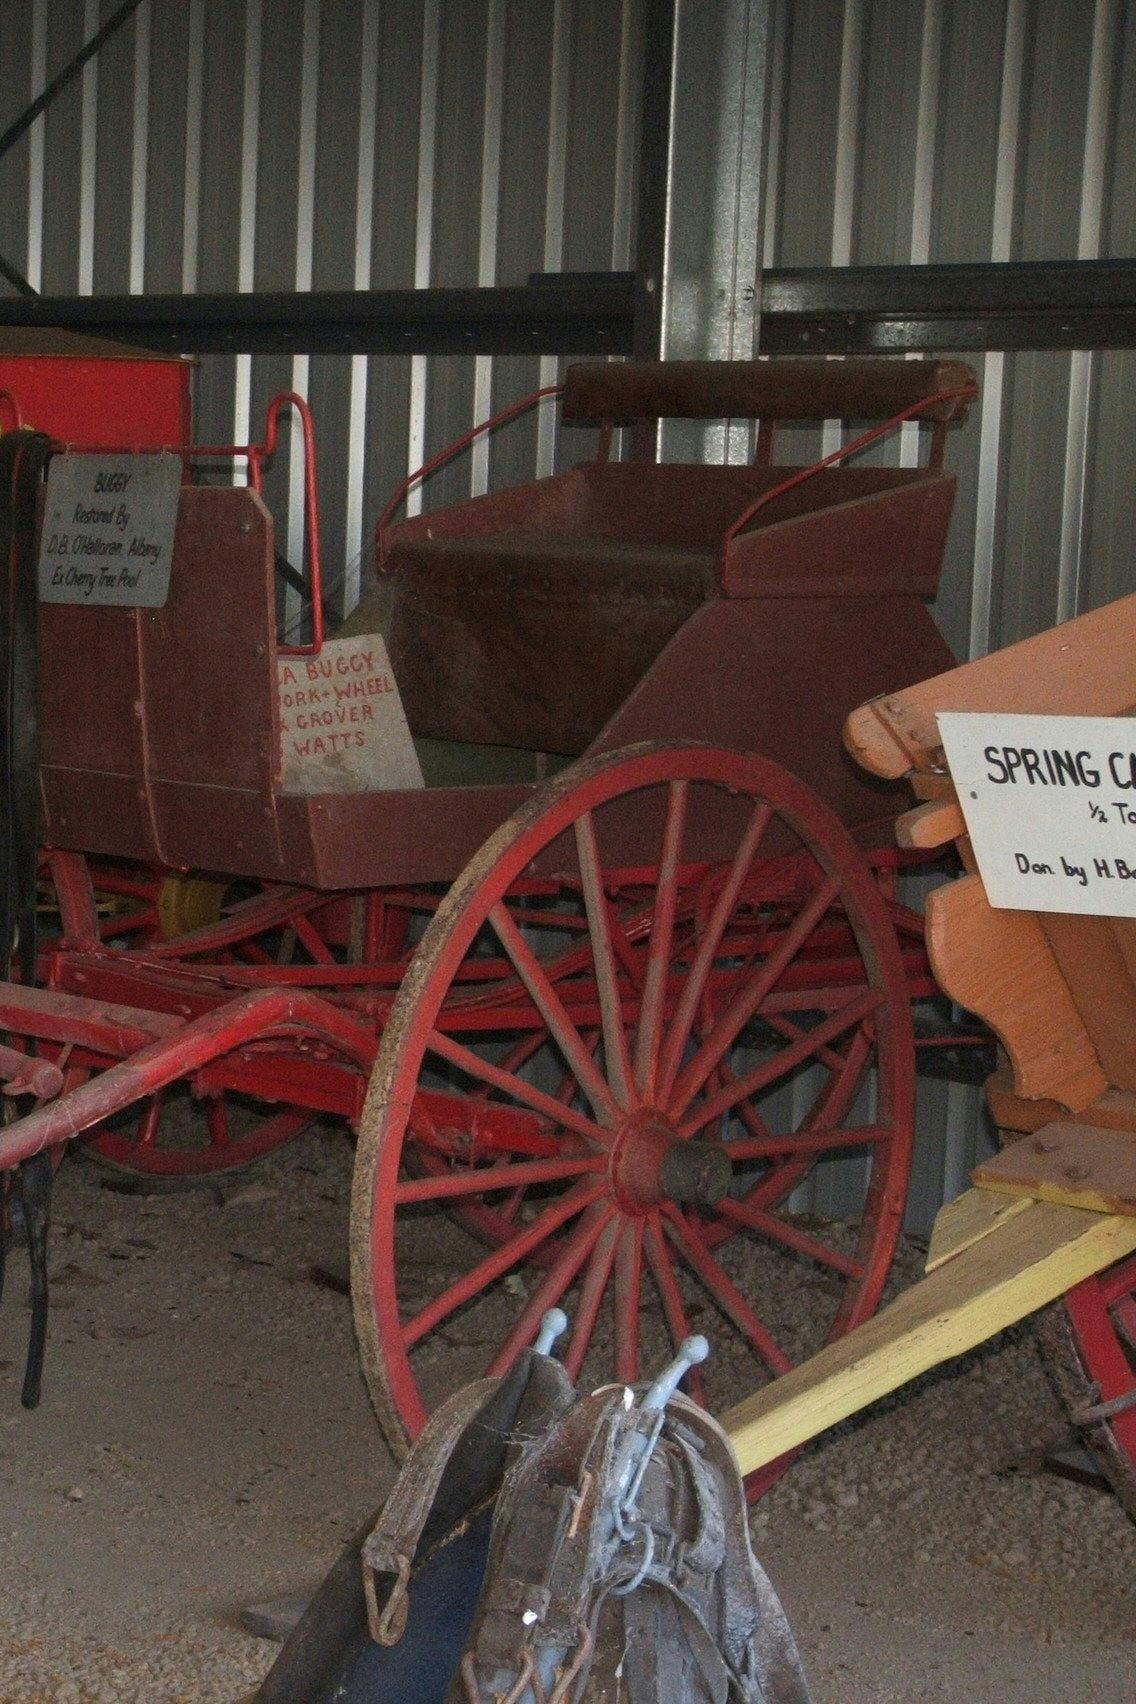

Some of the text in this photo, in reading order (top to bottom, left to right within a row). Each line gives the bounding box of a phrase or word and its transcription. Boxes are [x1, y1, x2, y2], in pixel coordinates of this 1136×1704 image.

[94, 472, 132, 493] BUGGY
[72, 503, 130, 531] Restored By
[66, 566, 97, 596] Cherry
[98, 567, 117, 588] Tree
[278, 651, 374, 686] A BUGGY
[296, 704, 374, 730] GROVER
[293, 731, 365, 756] WATTS
[984, 746, 1101, 788] SPRING
[1060, 856, 1088, 887] by
